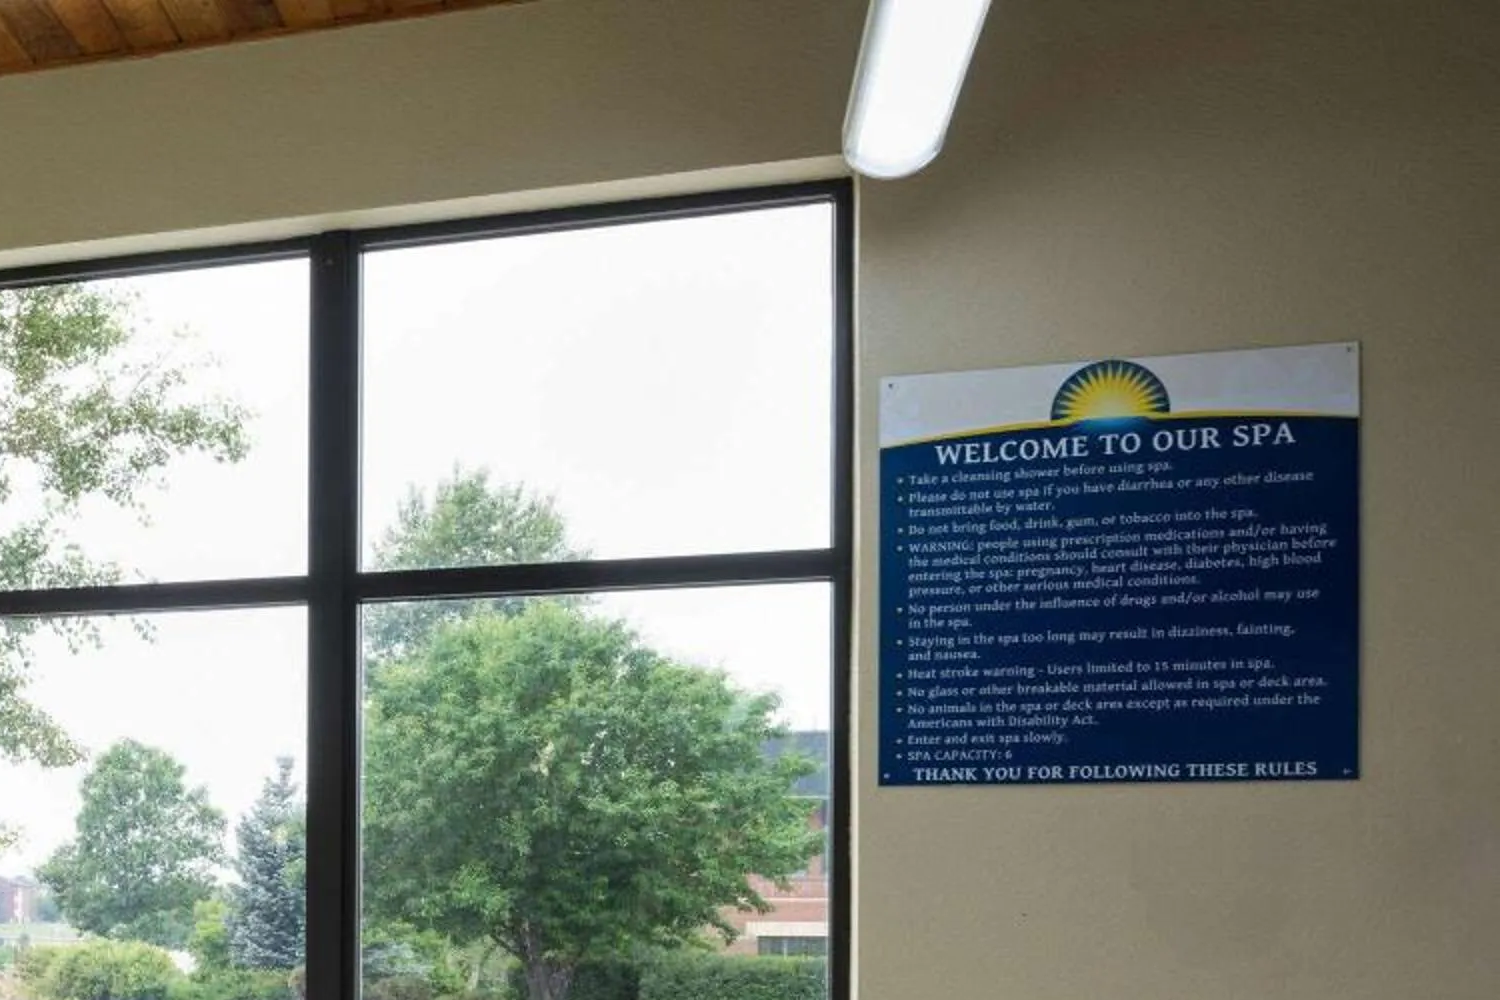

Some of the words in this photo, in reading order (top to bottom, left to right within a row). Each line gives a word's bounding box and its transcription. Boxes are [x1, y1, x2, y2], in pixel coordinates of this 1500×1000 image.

[935, 435, 1088, 464] WELCOME
[1099, 433, 1141, 454] TO
[1152, 427, 1220, 451] OUR
[1232, 422, 1297, 446] SPA
[910, 472, 938, 485] Take
[951, 468, 1010, 485] cleansing
[1014, 465, 1059, 479] shower
[1063, 462, 1104, 476] before
[1109, 460, 1143, 475] using
[908, 489, 946, 502] Please
[950, 488, 966, 500] do
[970, 487, 989, 499] not
[993, 488, 1014, 498] use
[1018, 487, 1038, 499] spa
[1043, 483, 1052, 495] if
[1056, 485, 1078, 497] you
[1083, 480, 1114, 493] have
[1176, 479, 1191, 488] or
[1195, 478, 1218, 490] any
[1223, 472, 1260, 486] other
[1264, 470, 1313, 483] disease
[996, 501, 1010, 515] by
[908, 523, 924, 535] Do
[928, 522, 948, 534] not
[952, 520, 986, 535] bring
[1101, 516, 1115, 525] or
[1119, 510, 1170, 524] tobacco
[1175, 509, 1201, 521] into
[1205, 508, 1227, 520] the
[977, 536, 1018, 552] people
[1023, 534, 1056, 550] using
[1061, 530, 1140, 548] prescription
[1144, 526, 1224, 542] medications
[1229, 524, 1275, 538] and/or
[1280, 522, 1328, 537] having
[908, 555, 928, 567] the
[983, 549, 1050, 563] conditions
[1054, 547, 1097, 560] should
[1152, 543, 1182, 556] with
[1186, 542, 1217, 554] their
[1223, 539, 1288, 555] physician
[1292, 537, 1338, 550] before
[965, 566, 984, 578] the
[1092, 560, 1125, 573] heart
[1249, 553, 1279, 568] high
[1283, 552, 1321, 564] blood
[968, 584, 982, 593] or
[985, 580, 1020, 592] other
[1024, 578, 1068, 591] serious
[1073, 576, 1122, 589] medical
[908, 602, 924, 614] No
[929, 603, 970, 615] person
[975, 598, 1010, 611] under
[1015, 598, 1036, 610] the
[1103, 595, 1116, 606] of
[1120, 593, 1156, 608] drugs
[1161, 591, 1206, 604] and/or
[1211, 589, 1258, 602] alcohol
[1264, 591, 1290, 603] may
[1297, 590, 1318, 599] use
[908, 617, 920, 629] in
[924, 616, 944, 628] the
[909, 634, 954, 649] Staying
[958, 634, 970, 645] in
[974, 633, 994, 645] the
[998, 635, 1018, 646] spa
[1022, 631, 1044, 643] too
[1047, 630, 1074, 645] long
[1079, 632, 1104, 644] may
[1109, 628, 1146, 641] result
[1151, 628, 1164, 639] in
[908, 649, 930, 660] and
[908, 667, 936, 679] Heat
[940, 666, 978, 678] stroke
[982, 664, 1034, 679] warning
[1047, 663, 1082, 675] Users
[1087, 661, 1132, 674] limited
[1136, 661, 1150, 672] to
[1155, 660, 1168, 672] 15
[1172, 659, 1226, 671] minutes
[1231, 658, 1243, 670] in
[908, 685, 924, 696] No
[928, 684, 958, 698] glass
[961, 687, 975, 695] or
[979, 683, 1012, 695] other
[1017, 681, 1078, 694] breakable
[1083, 680, 1136, 692] material
[1141, 678, 1192, 691] allowed
[1196, 678, 1208, 689] in
[1213, 680, 1235, 691] spa
[1239, 680, 1254, 688] or
[1258, 676, 1288, 688] deck
[908, 702, 924, 714] No
[929, 701, 976, 713] animals
[980, 700, 992, 712] in
[996, 700, 1016, 711] the
[1020, 702, 1040, 713] spa
[1045, 702, 1057, 710] or
[1062, 698, 1092, 710] deck
[1096, 700, 1122, 709] area
[1126, 696, 1169, 711] except
[1191, 694, 1248, 709] required
[1253, 693, 1292, 705] under
[1297, 693, 1320, 704] the
[908, 716, 972, 729] Americans
[976, 715, 1004, 727] with
[1009, 714, 1068, 729] Disability
[908, 733, 940, 745] Enter
[944, 733, 967, 744] and
[971, 732, 994, 744] exit
[999, 735, 1020, 746] spa
[908, 749, 930, 761] SPA
[934, 748, 1001, 760] CAPACITY:
[1004, 748, 1012, 759] 6
[913, 768, 976, 781] THANK
[984, 767, 1020, 780] YOU
[1027, 766, 1062, 779] FOR
[1069, 764, 1180, 779] FOLLOWING
[1187, 763, 1250, 776] THESE
[1254, 761, 1317, 775] RULES
